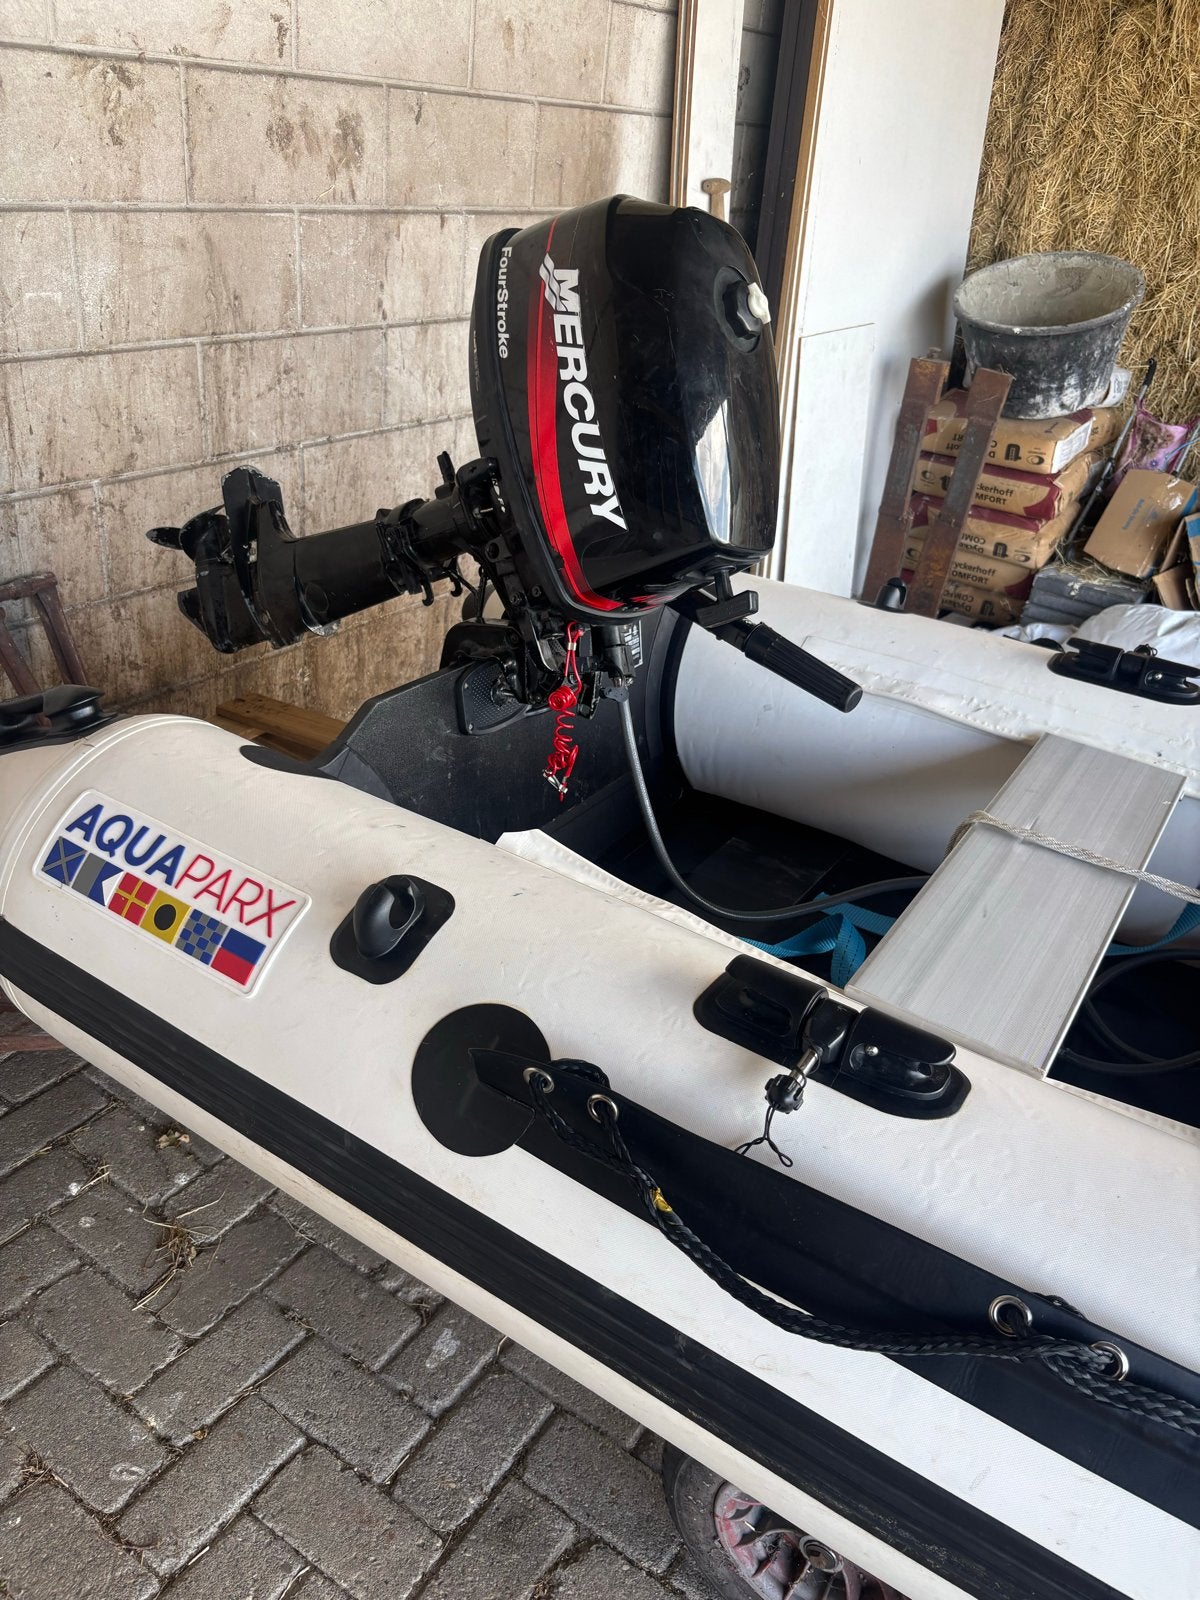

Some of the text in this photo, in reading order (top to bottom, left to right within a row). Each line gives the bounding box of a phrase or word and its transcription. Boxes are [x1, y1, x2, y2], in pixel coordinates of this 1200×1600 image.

[497, 246, 511, 360] FourStroke
[553, 268, 628, 532] MERCURY
[65, 803, 297, 938] AQUAPARX
